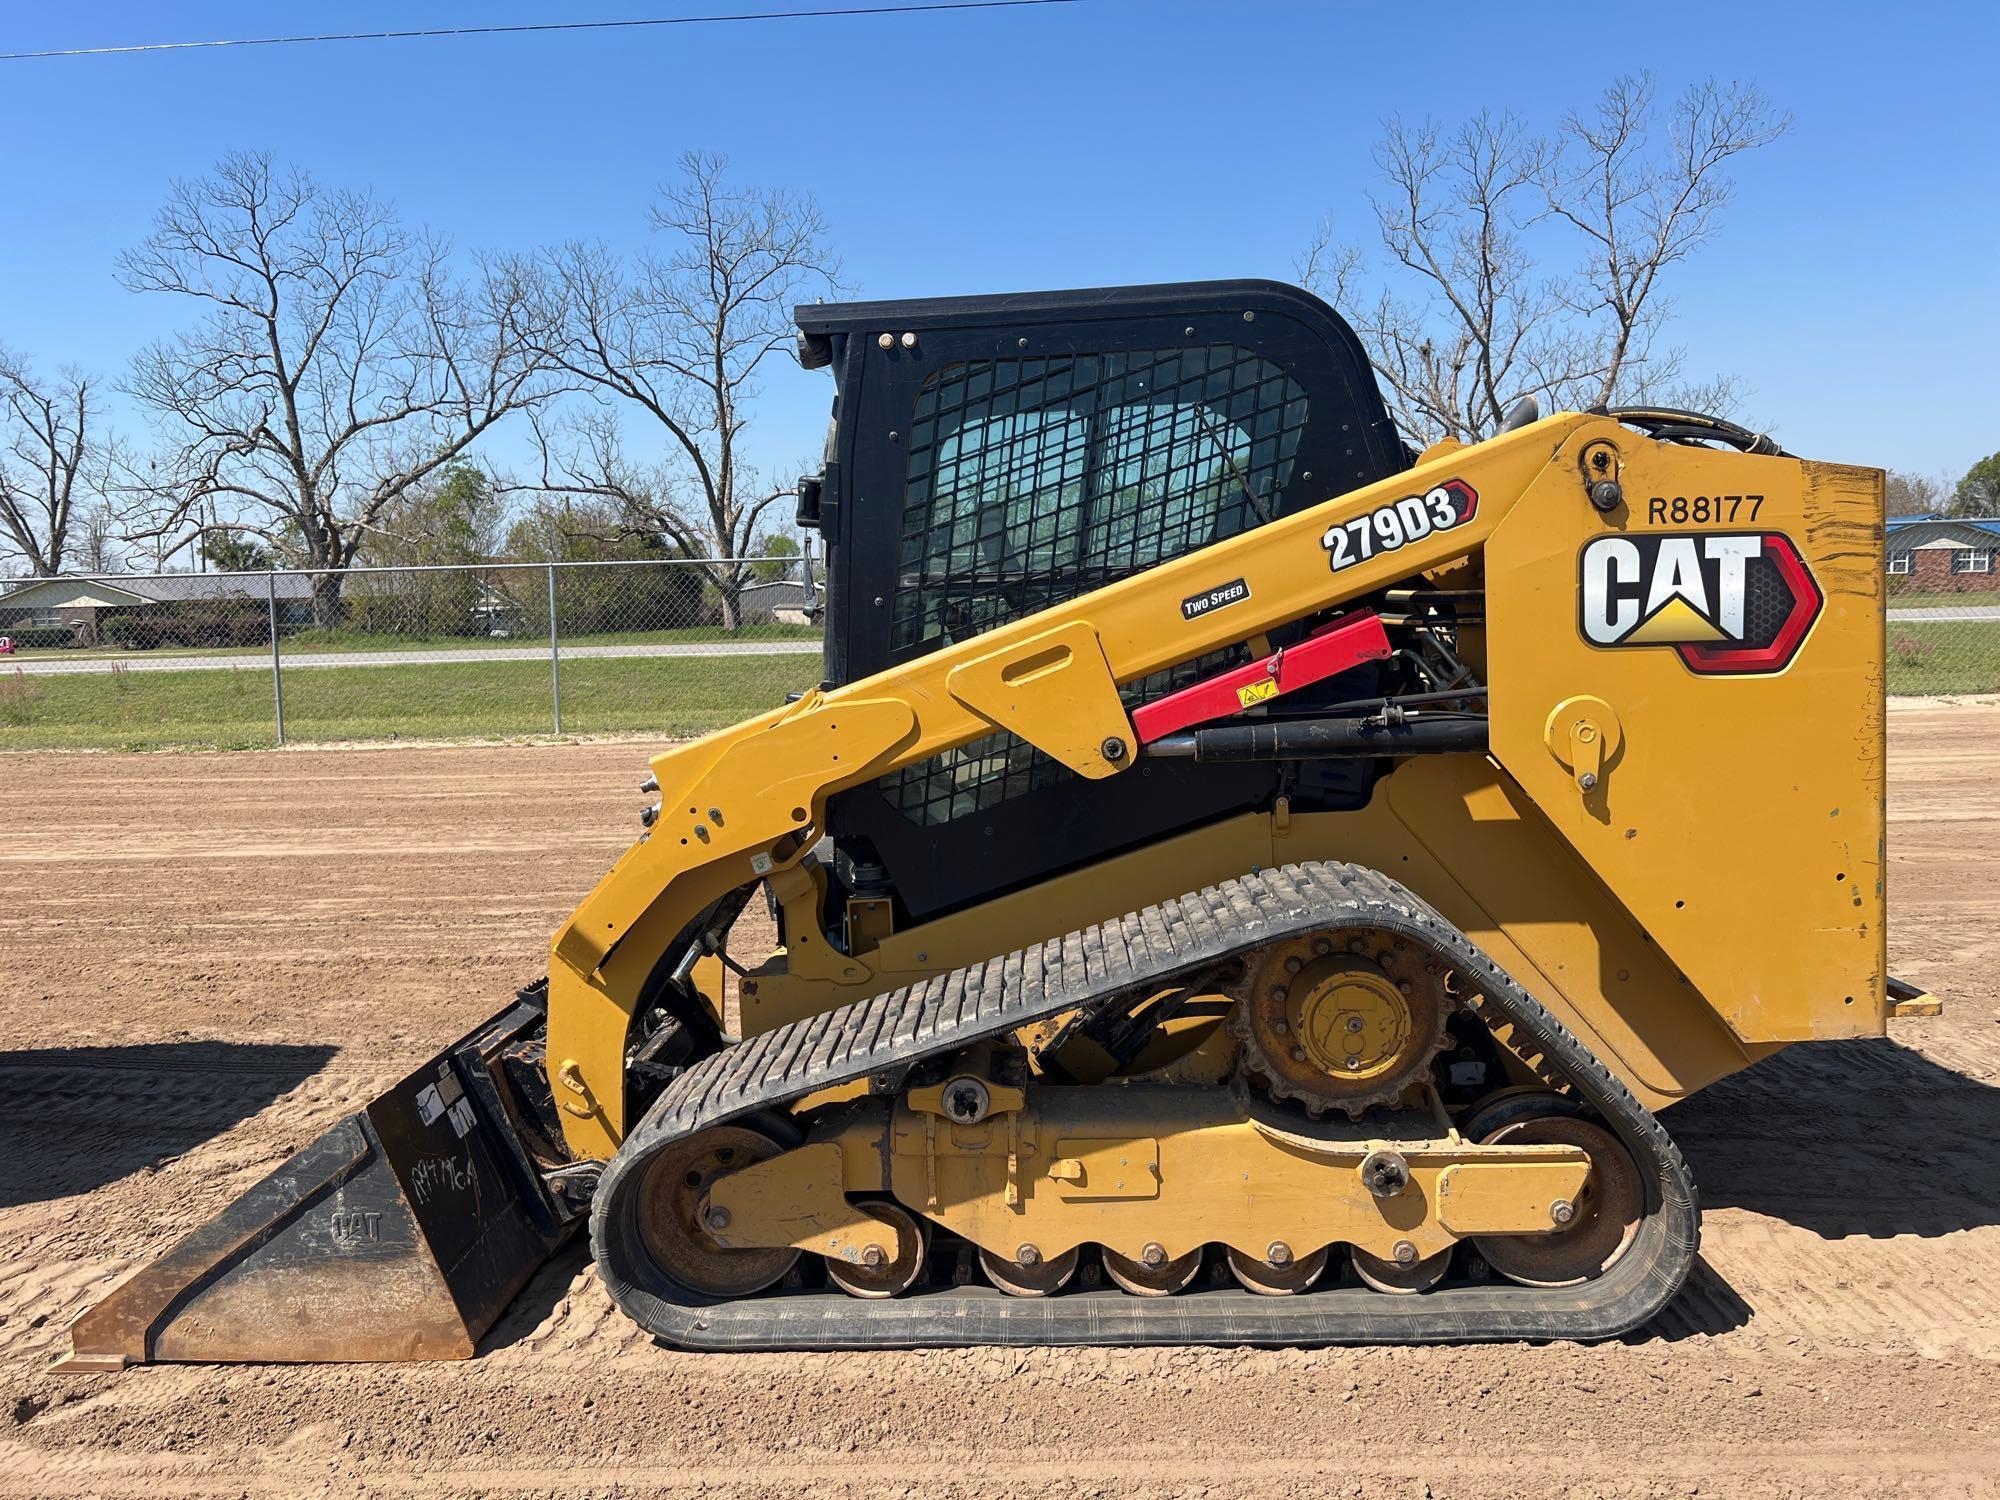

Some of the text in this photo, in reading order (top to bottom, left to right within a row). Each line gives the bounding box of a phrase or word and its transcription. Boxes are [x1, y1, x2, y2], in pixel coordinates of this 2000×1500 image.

[1323, 487, 1457, 570] 279D3
[1648, 495, 1765, 525] R88177
[1583, 535, 1762, 644] CAT
[331, 1212, 382, 1243] CAT
